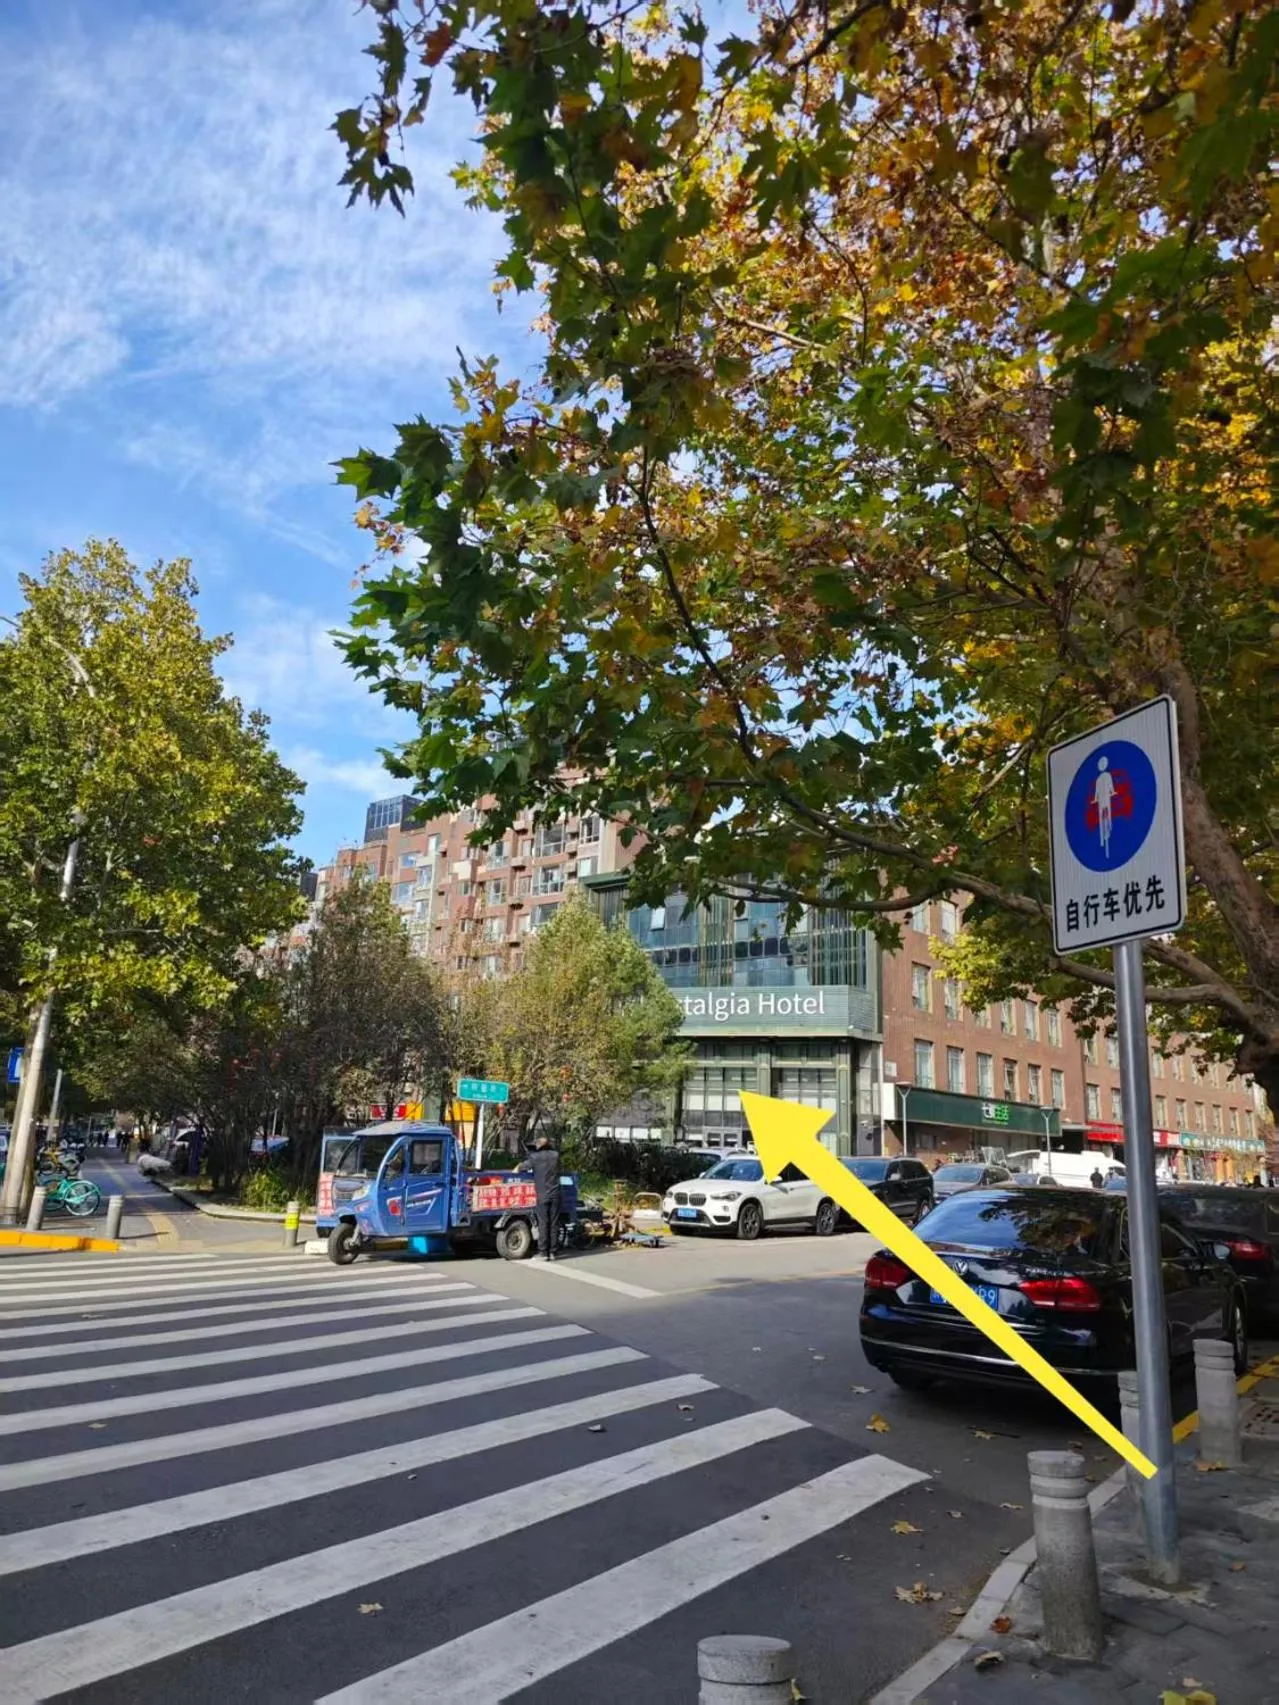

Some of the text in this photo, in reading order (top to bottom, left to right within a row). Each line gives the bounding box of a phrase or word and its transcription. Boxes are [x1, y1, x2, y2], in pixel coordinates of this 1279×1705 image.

[1066, 875, 1165, 932] 自行车优先
[678, 991, 825, 1021] talgia Hotel
